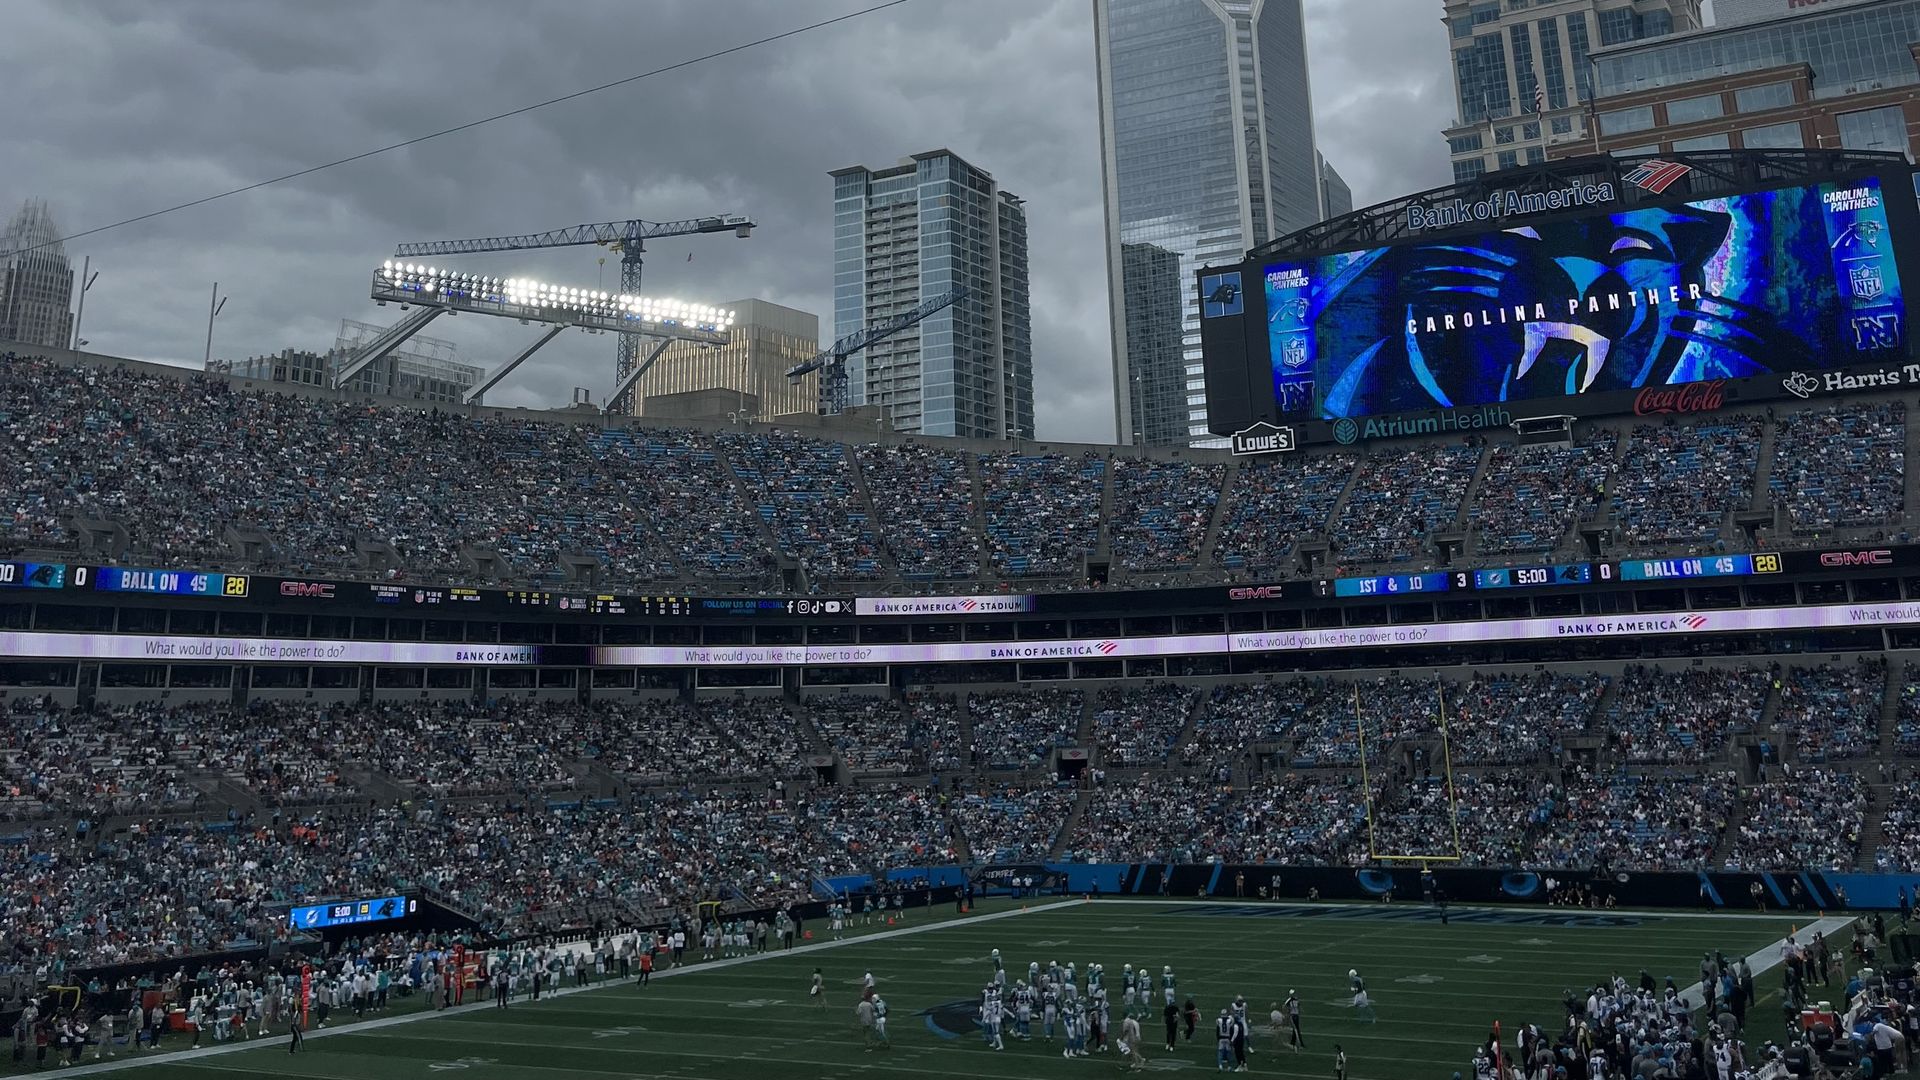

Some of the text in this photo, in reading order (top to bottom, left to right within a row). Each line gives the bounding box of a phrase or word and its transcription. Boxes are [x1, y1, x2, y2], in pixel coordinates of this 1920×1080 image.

[1823, 187, 1869, 203] CAROLINA
[1407, 180, 1614, 231] Bank of America
[1830, 196, 1879, 213] PANTHERS
[1267, 268, 1302, 283] CAROLINA
[1272, 276, 1309, 291] PANTHERS
[1854, 279, 1882, 295] NFL
[1407, 281, 1723, 334] CAROLINA PANTHERS
[1285, 347, 1304, 363] NFL
[1823, 364, 1920, 391] Harris T
[1633, 380, 1727, 416] Coca-Cola
[1363, 406, 1510, 439] Atrium Health
[1237, 433, 1288, 452] LOWE'S
[1756, 556, 1777, 571] 28
[1821, 551, 1893, 567] GMC
[1601, 564, 1610, 579] 0
[1644, 559, 1733, 577] BALL ON 45
[75, 567, 87, 586] 0
[121, 570, 207, 592] BALL ON 45
[1457, 573, 1467, 587] 3
[1518, 569, 1547, 585] 5:00
[227, 577, 245, 595] 28
[280, 581, 336, 599] GMC
[1229, 585, 1282, 600] GMC
[1359, 576, 1422, 594] 1ST & 10
[703, 600, 785, 609] FOLLOW US ON SOCIAL
[874, 601, 1023, 613] BANK OF AMERICA STADIUM
[1850, 609, 1882, 621] What
[1558, 620, 1677, 635] BANK OF AMERICA
[1238, 628, 1428, 651] What would you like the power to do?
[145, 641, 345, 662] What would you like the power to do?
[456, 652, 484, 662] BANK
[486, 652, 500, 662] OF
[685, 650, 872, 665] What would you like the power to do?
[991, 646, 1093, 658] BANK OF AMERICA
[335, 905, 351, 918] 5:00
[410, 899, 416, 913] 0
